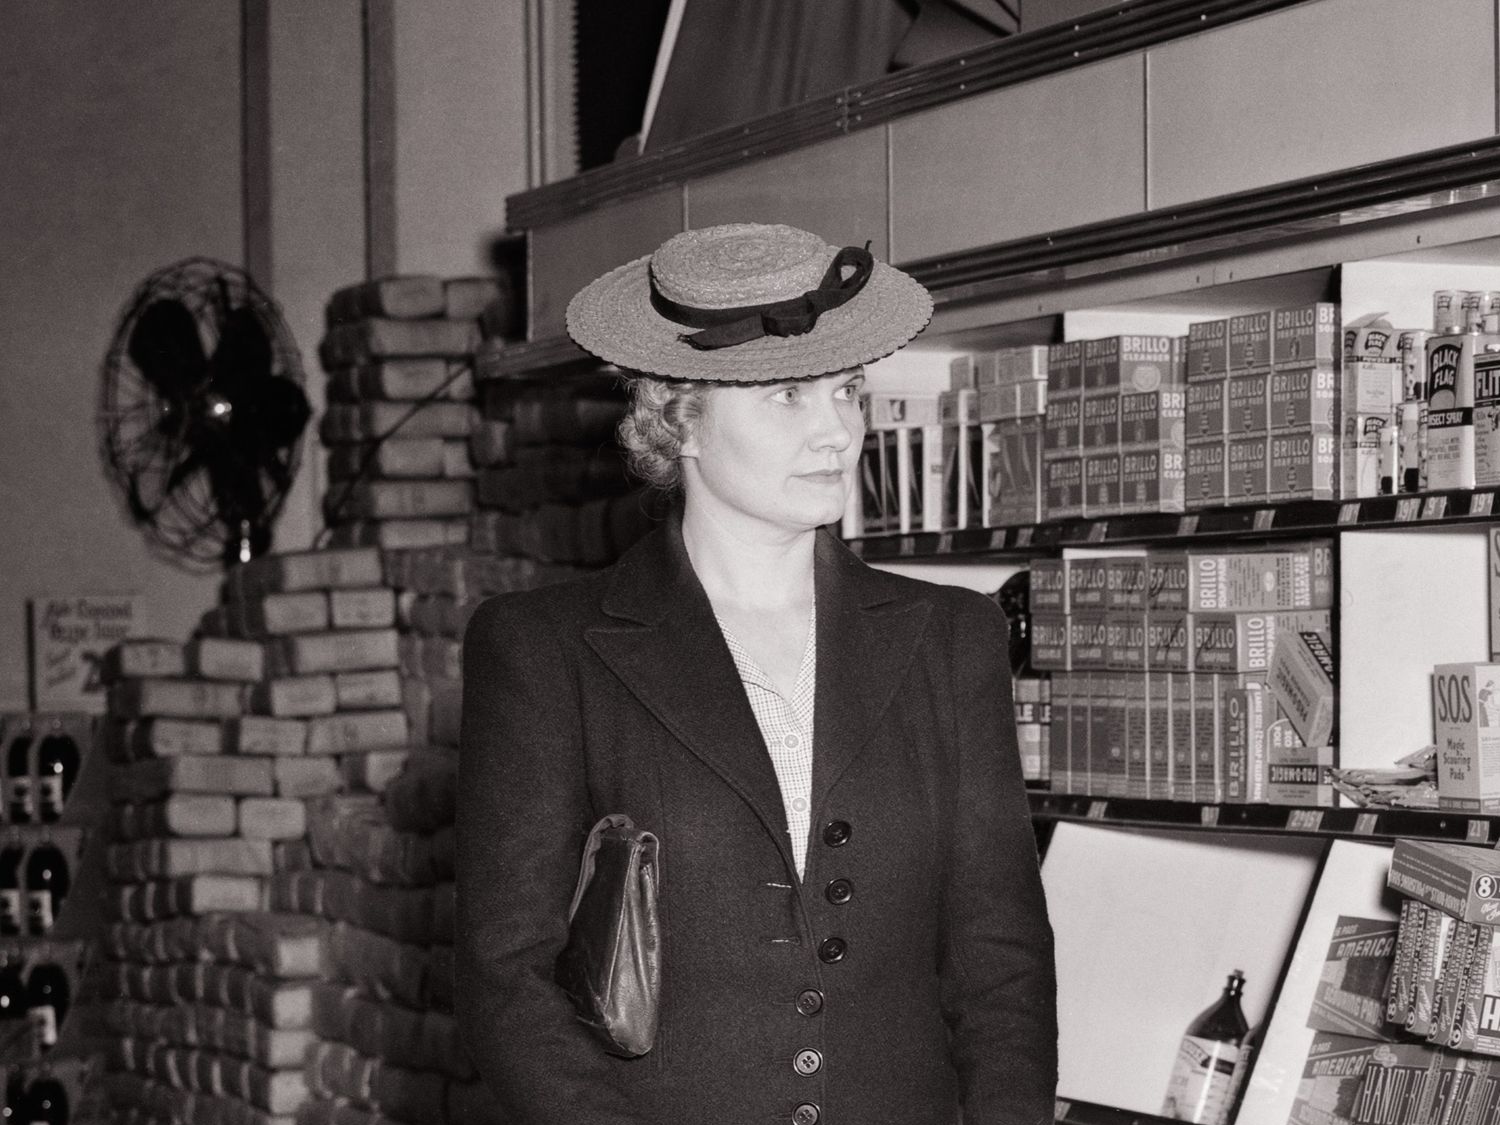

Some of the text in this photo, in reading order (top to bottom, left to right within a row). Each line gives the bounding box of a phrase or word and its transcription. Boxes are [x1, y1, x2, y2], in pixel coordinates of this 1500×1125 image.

[1231, 314, 1268, 334] BRILLO
[1123, 337, 1169, 353] BRILLO
[1432, 349, 1459, 367] BLACK
[1434, 371, 1454, 389] FLAG
[1476, 370, 1500, 396] FLIT
[1447, 410, 1463, 424] SPRAY
[1478, 877, 1492, 898] 8
